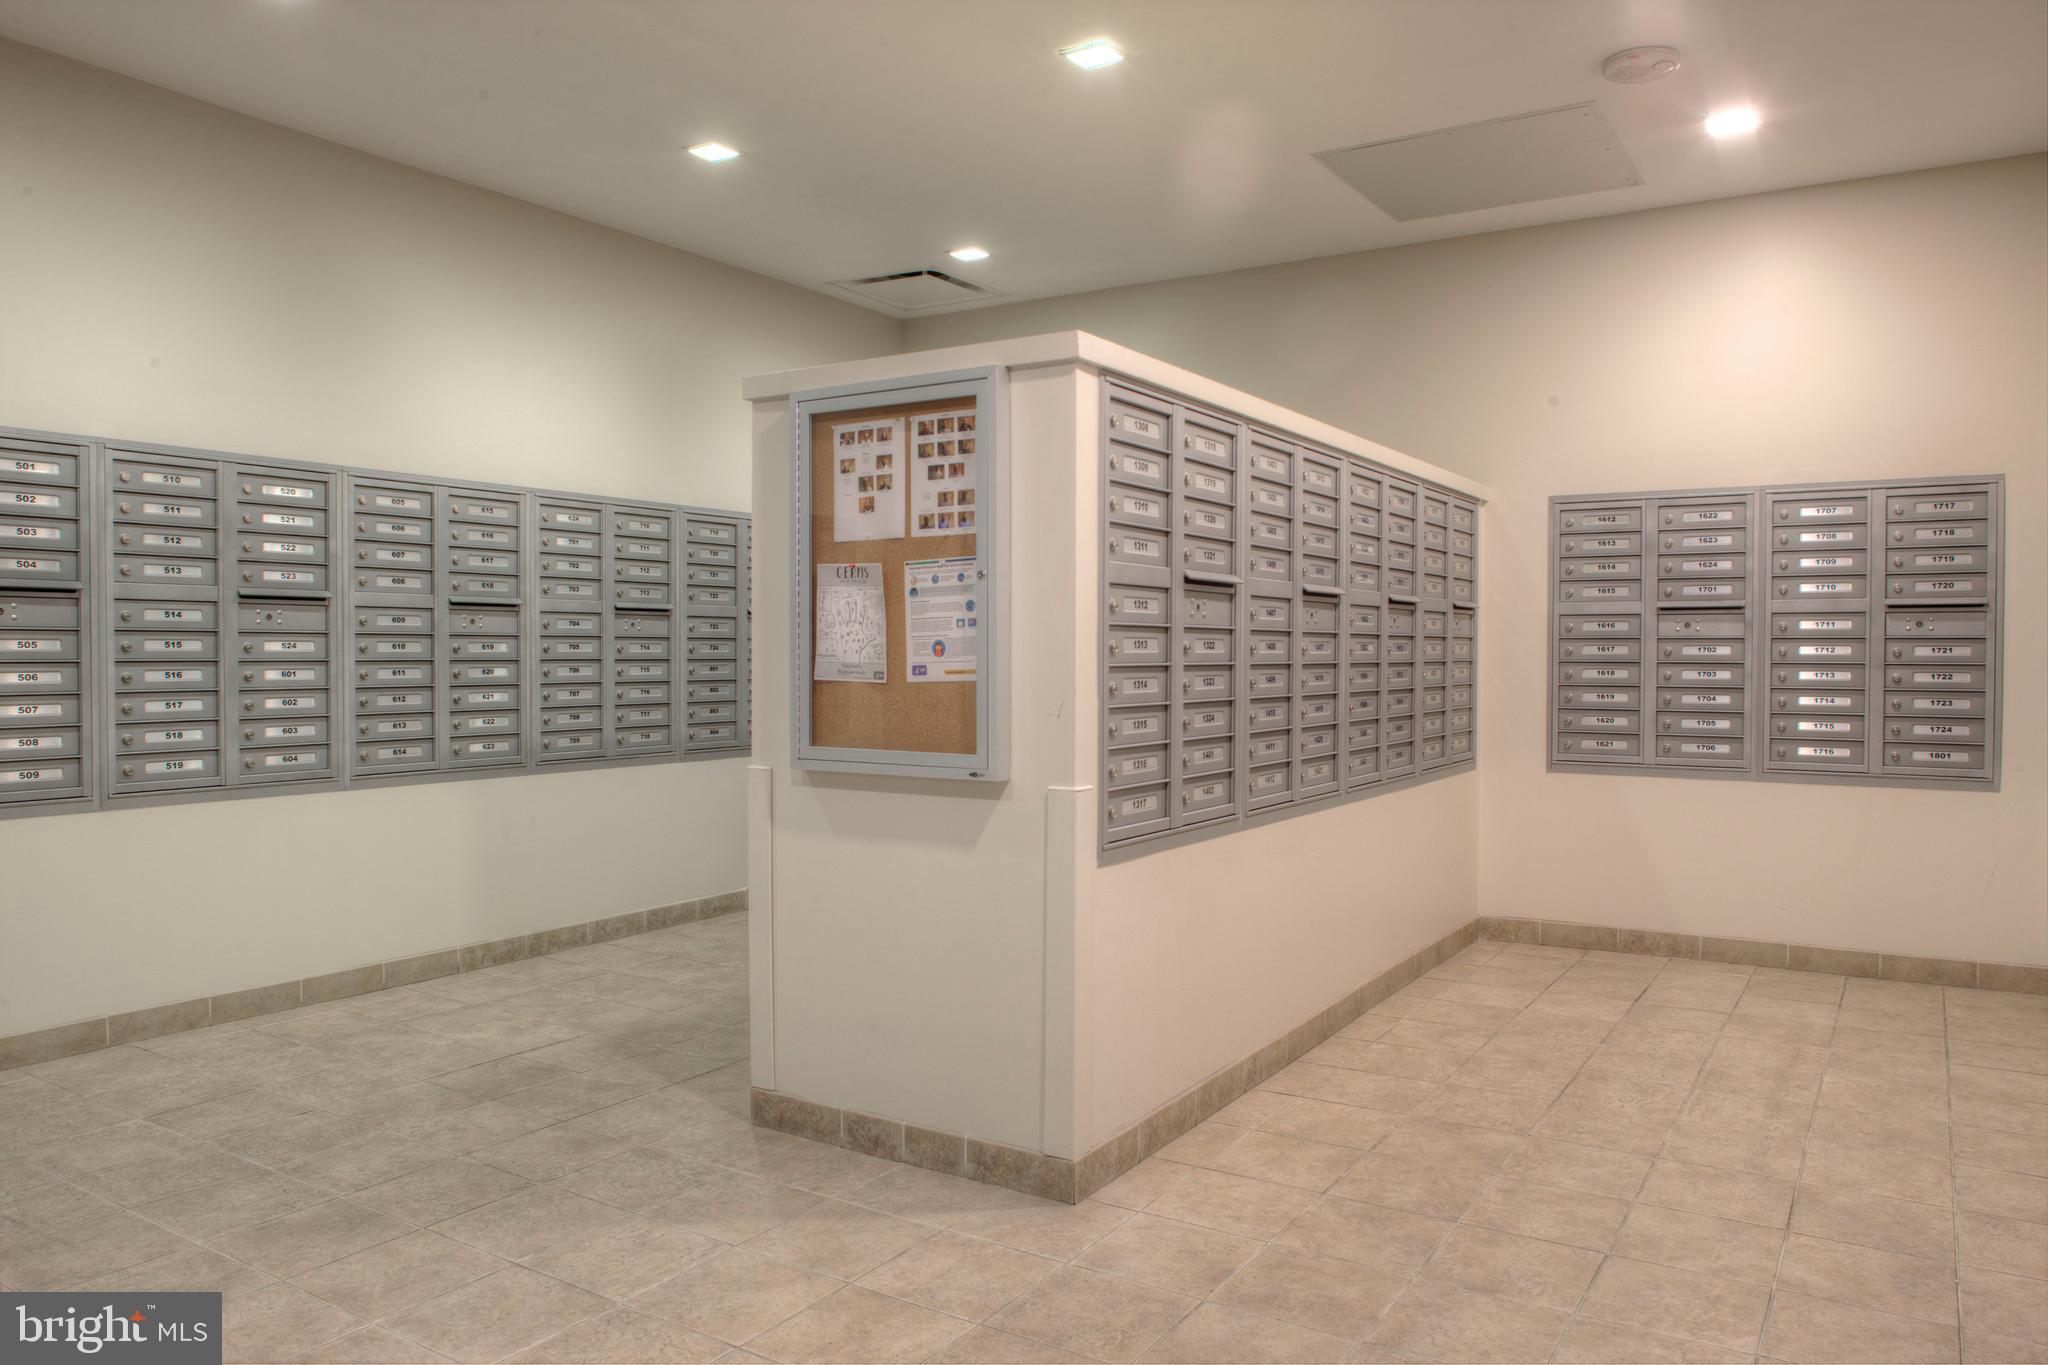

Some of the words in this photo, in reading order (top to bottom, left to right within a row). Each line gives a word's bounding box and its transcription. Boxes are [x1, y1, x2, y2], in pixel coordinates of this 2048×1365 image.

[15, 461, 35, 470] 501
[163, 475, 181, 484] 510
[280, 487, 296, 496] 520
[15, 494, 36, 503] 502
[391, 498, 405, 506] 605
[163, 505, 181, 514] 511
[1134, 501, 1149, 512] 1310
[1933, 502, 1956, 510] 1717
[280, 516, 296, 524] 521
[1699, 512, 1718, 520] 1622
[16, 527, 37, 536] 503
[391, 524, 406, 532] 606
[163, 536, 182, 545] 512
[1698, 536, 1718, 544] 1623
[280, 544, 297, 552] 522
[1133, 541, 1148, 551] 1311
[1932, 555, 1955, 563] 1719
[16, 560, 37, 569] 504
[164, 566, 182, 575] 513
[281, 572, 297, 580] 523
[391, 577, 406, 585] 608
[568, 585, 580, 593] 703
[1134, 599, 1149, 610] 1312
[164, 610, 182, 618] 514
[391, 616, 406, 624] 609
[17, 640, 38, 649] 505
[164, 641, 182, 649] 515
[1133, 639, 1148, 649] 1313
[18, 673, 39, 682] 506
[164, 671, 183, 679] 516
[281, 670, 296, 678] 601
[1133, 680, 1148, 690] 1314
[569, 688, 580, 697] 707
[282, 698, 298, 706] 602
[392, 695, 407, 703] 612
[1930, 699, 1953, 707] 1723
[18, 705, 39, 714] 507
[165, 701, 183, 709] 517
[392, 721, 407, 729] 613
[1133, 719, 1148, 730] 1315
[282, 726, 298, 735] 603
[165, 731, 183, 740] 518
[569, 736, 581, 744] 709
[18, 738, 39, 747] 508
[392, 748, 407, 756] 614
[282, 755, 298, 763] 604
[166, 761, 184, 770] 519
[1133, 759, 1147, 770] 1316
[19, 771, 40, 780] 509
[1132, 798, 1147, 809] 1317
